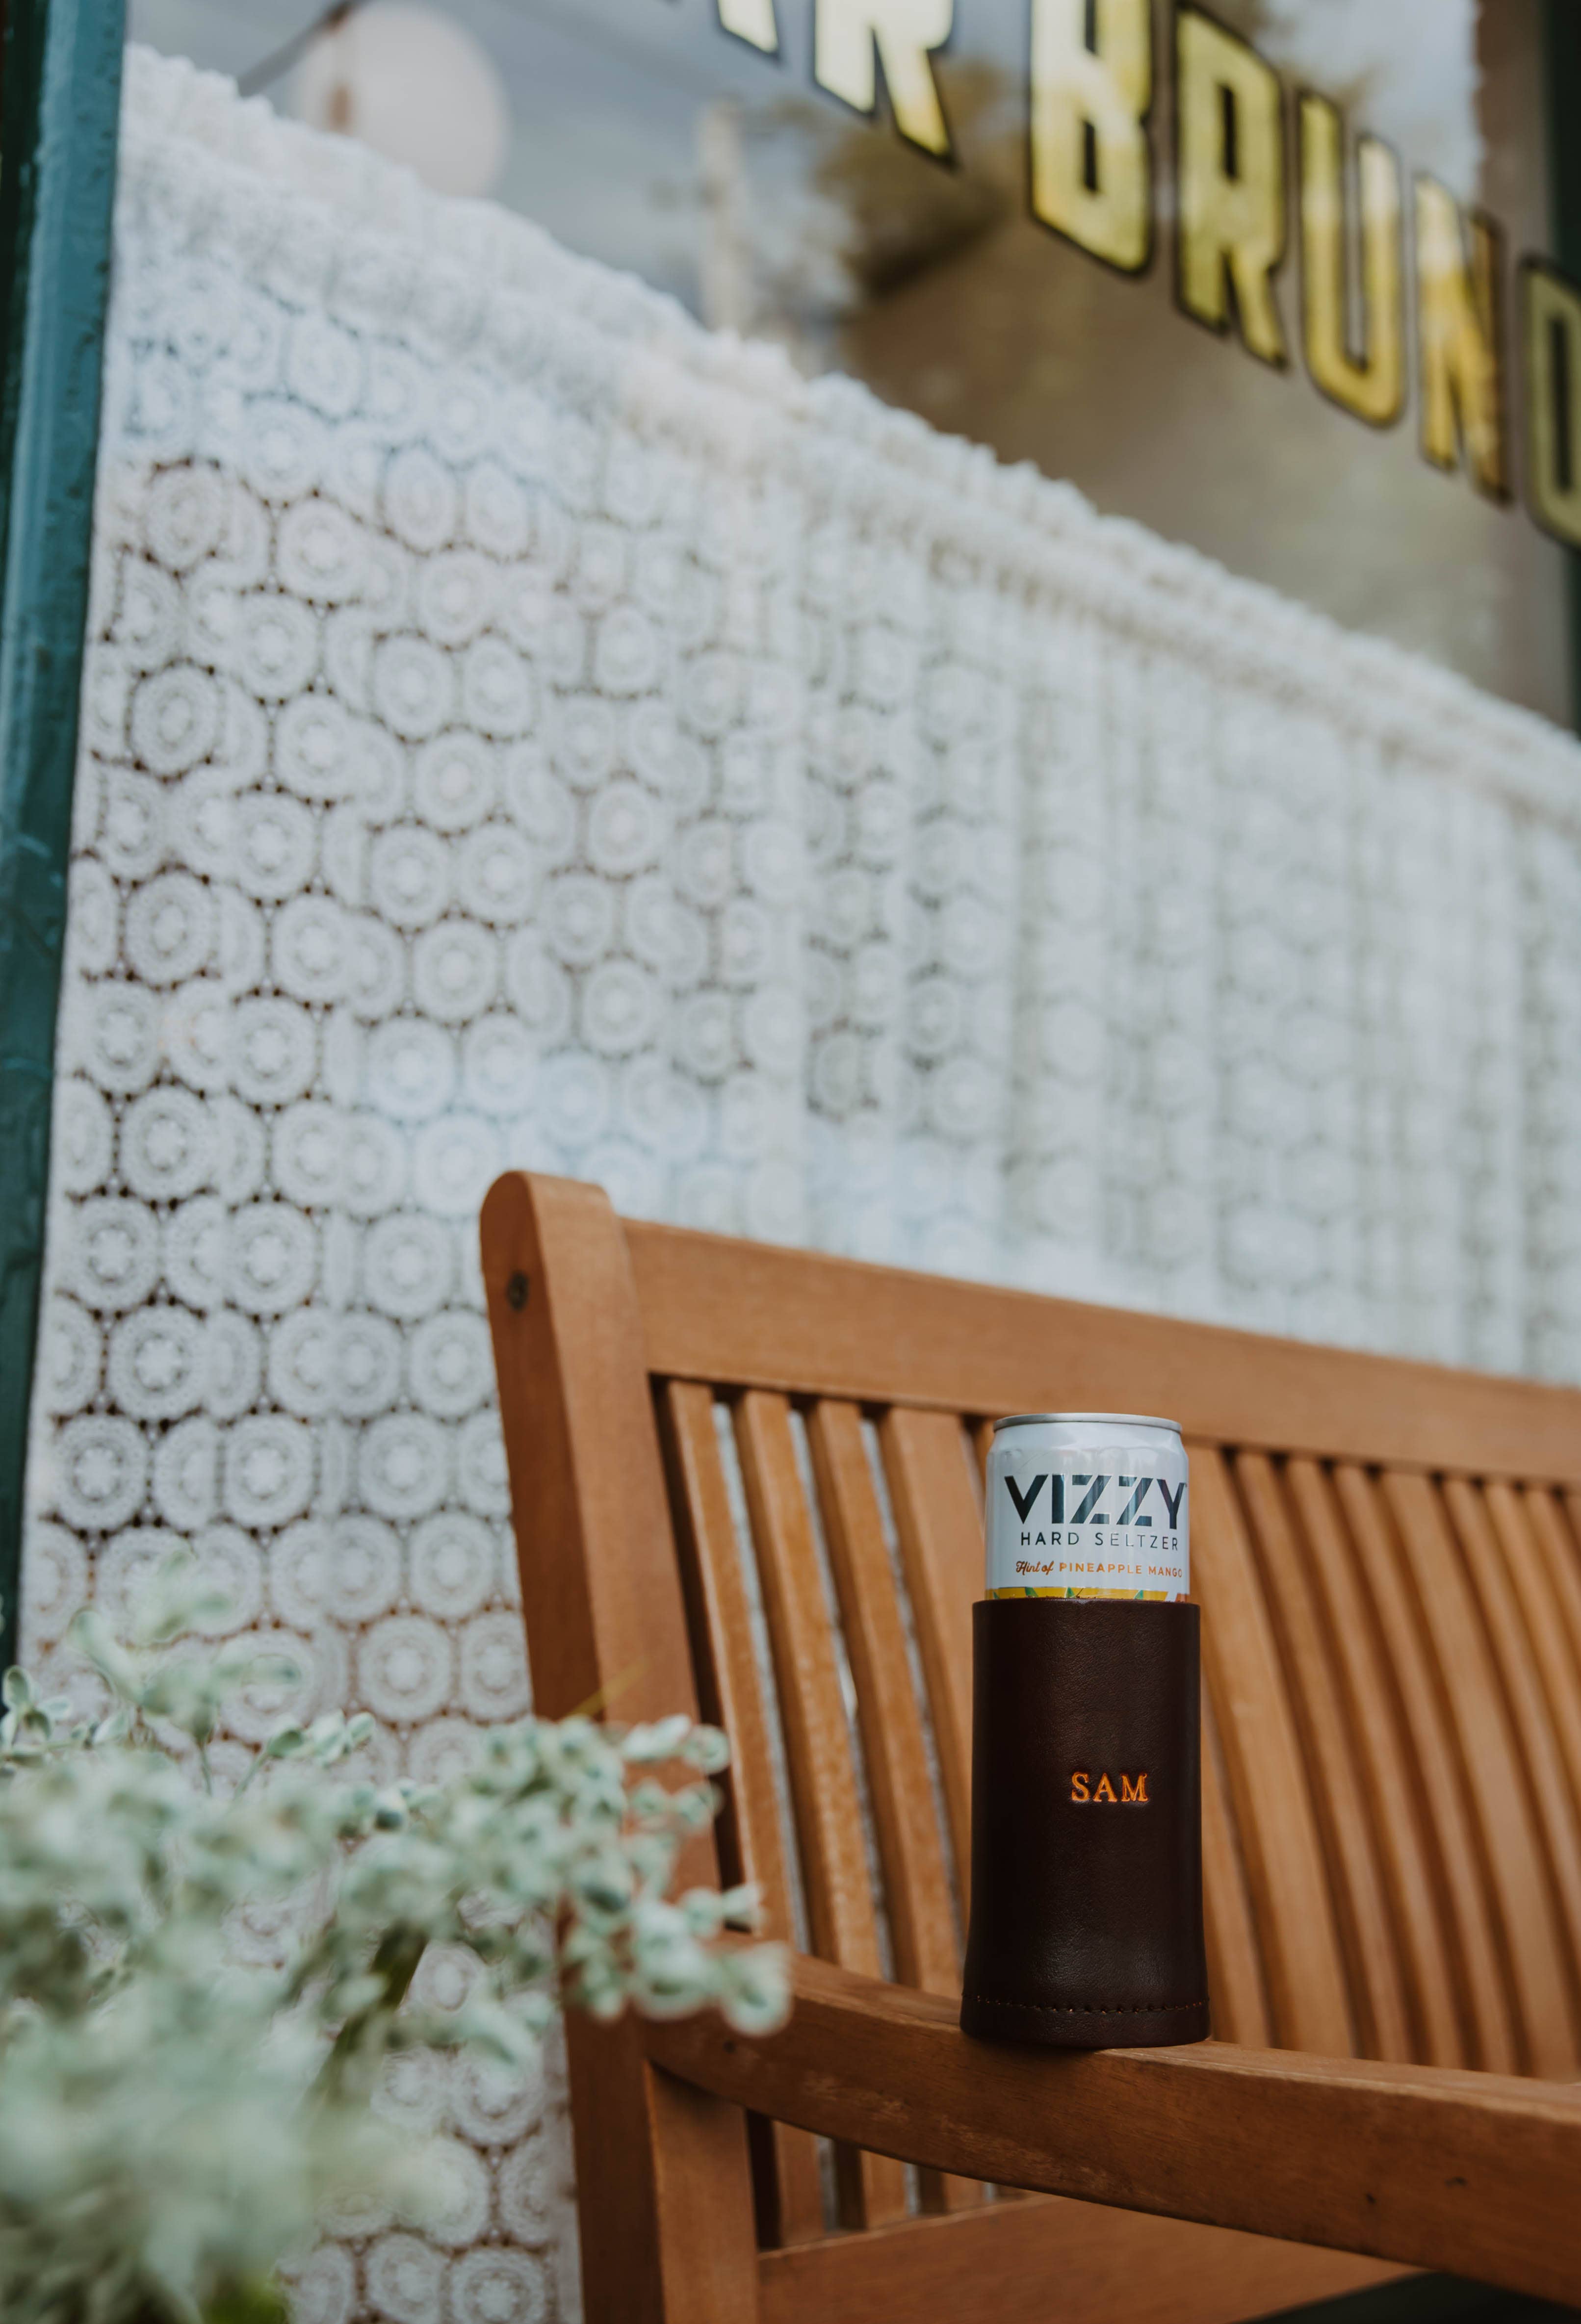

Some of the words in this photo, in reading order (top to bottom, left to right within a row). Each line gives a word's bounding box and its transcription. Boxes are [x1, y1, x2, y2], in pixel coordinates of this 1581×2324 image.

[1004, 1473, 1185, 1529] VIZZY
[1021, 1532, 1079, 1546] HARD
[1095, 1532, 1178, 1550] SELTZER
[1016, 1561, 1040, 1575] Hint
[1041, 1561, 1054, 1575] of
[1059, 1562, 1142, 1574] PINEAPPLE
[1148, 1566, 1182, 1577] MANGO
[1071, 1771, 1148, 1802] SAM
